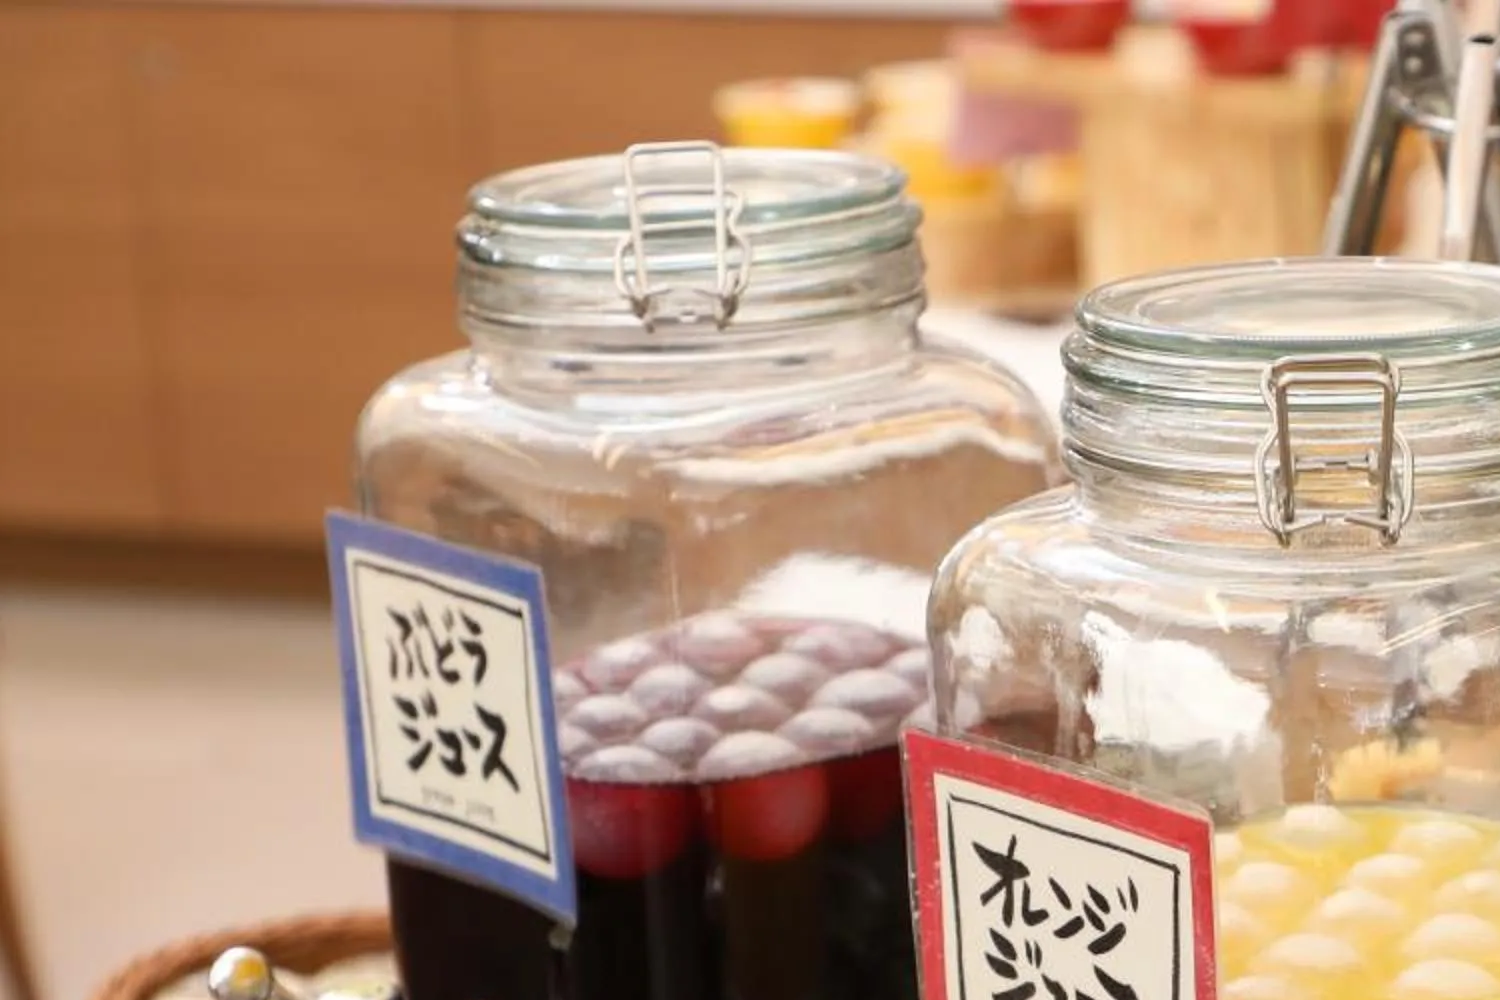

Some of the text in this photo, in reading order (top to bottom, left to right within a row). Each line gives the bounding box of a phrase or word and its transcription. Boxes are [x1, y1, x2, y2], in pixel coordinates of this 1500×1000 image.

[384, 601, 488, 688] ぶどう
[391, 690, 521, 792] ジュース
[971, 834, 1139, 955] オレンジ
